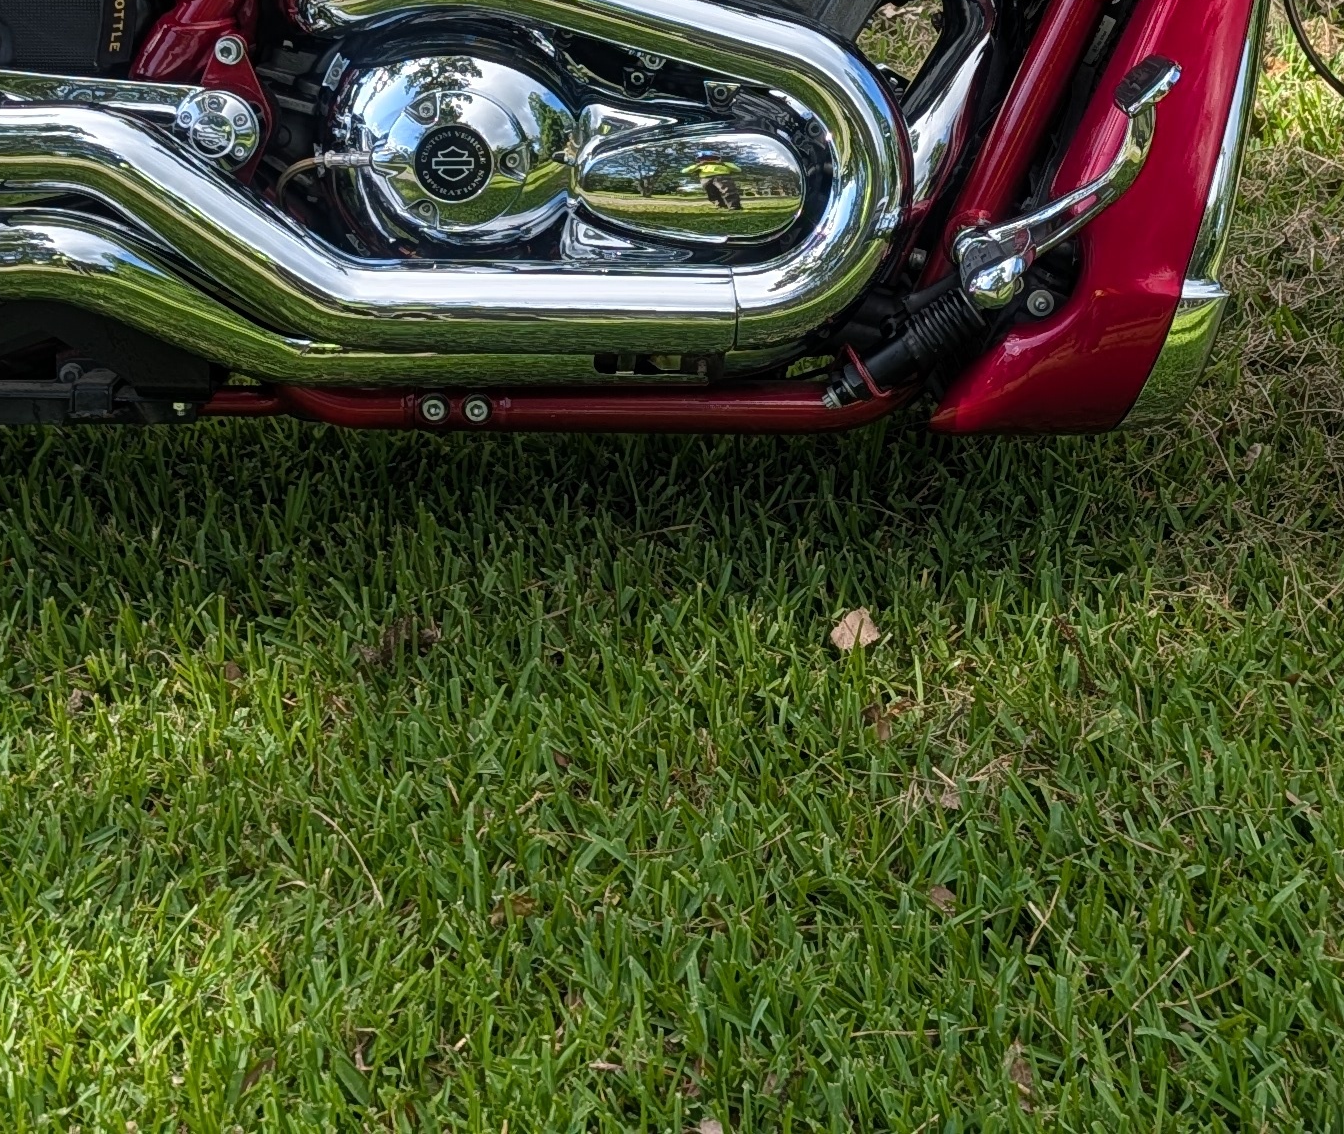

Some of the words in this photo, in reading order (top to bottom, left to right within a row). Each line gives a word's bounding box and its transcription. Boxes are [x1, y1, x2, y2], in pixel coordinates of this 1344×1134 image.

[420, 131, 452, 163] CUSTOM
[454, 131, 487, 164] VEHICLE
[422, 169, 485, 196] OPERATIONS
